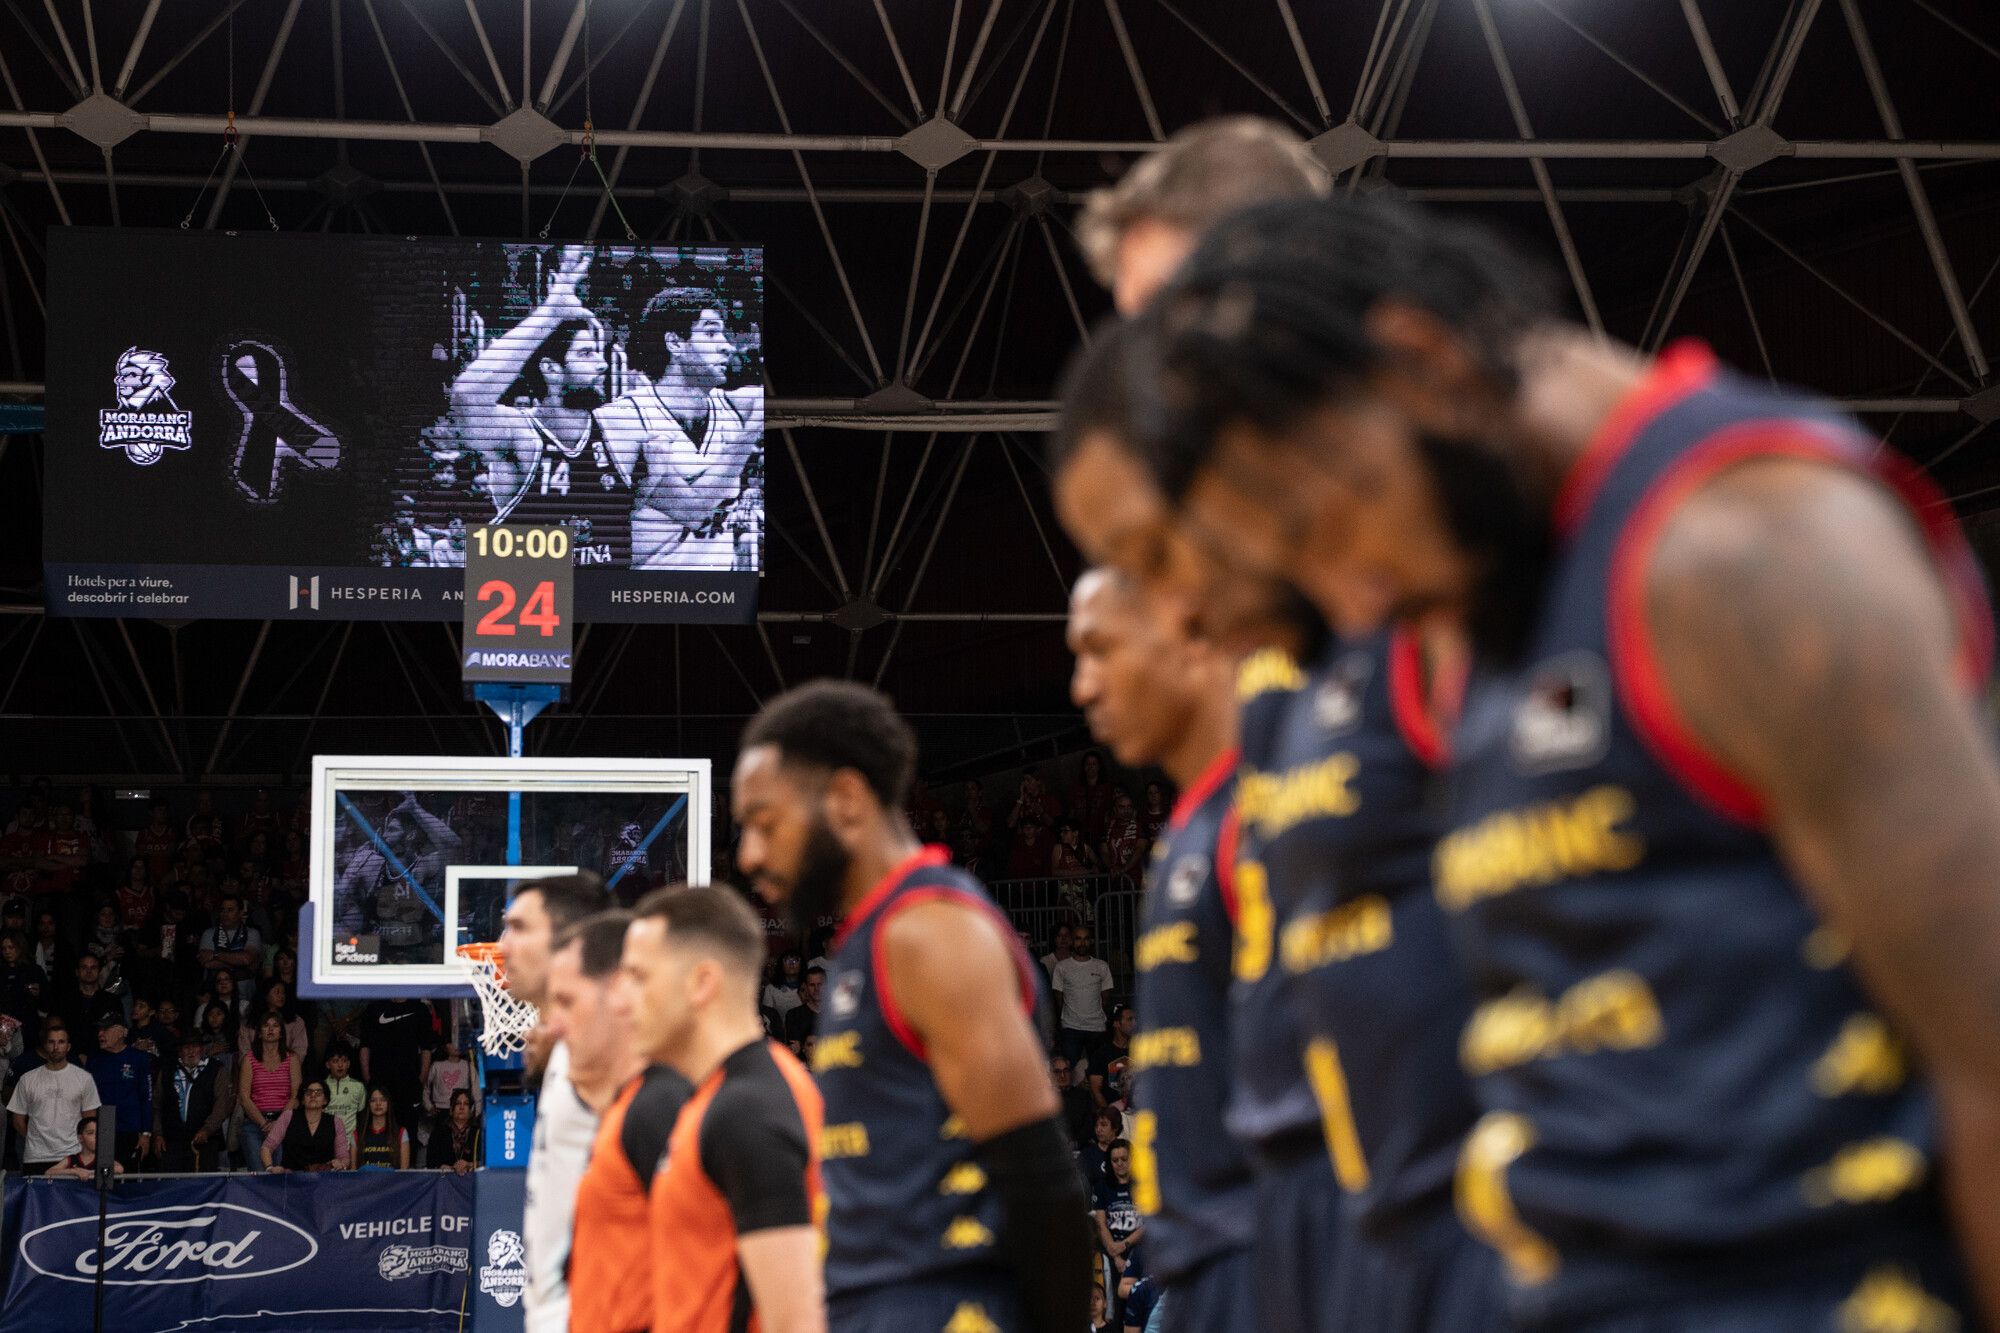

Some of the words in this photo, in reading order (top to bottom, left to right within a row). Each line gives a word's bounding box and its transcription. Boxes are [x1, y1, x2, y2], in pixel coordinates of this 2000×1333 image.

[104, 412, 187, 425] MORABANC
[104, 424, 187, 443] ANDORRA
[541, 458, 571, 496] 14
[473, 527, 568, 559] 10:00
[573, 545, 612, 565] TINA
[68, 575, 106, 587] Hotels
[108, 578, 127, 589] per
[128, 580, 136, 588] a
[139, 577, 173, 589] viure,
[67, 591, 127, 603] descobrir
[137, 592, 189, 604] celebrar
[331, 587, 422, 600] HESPERIA
[611, 590, 736, 604] HESPERIA.COM
[475, 579, 560, 637] 24
[482, 653, 570, 668] MORABANC
[335, 942, 356, 955] liga
[503, 1110, 516, 1160] MONDO
[340, 1216, 432, 1240] VEHICLE
[440, 1214, 473, 1233] OF
[75, 1215, 261, 1274] Ford
[410, 1248, 465, 1257] MORABANC
[409, 1254, 465, 1268] ANDORRA
[483, 1269, 526, 1278] MORABAN
[482, 1277, 525, 1289] ANDORR
